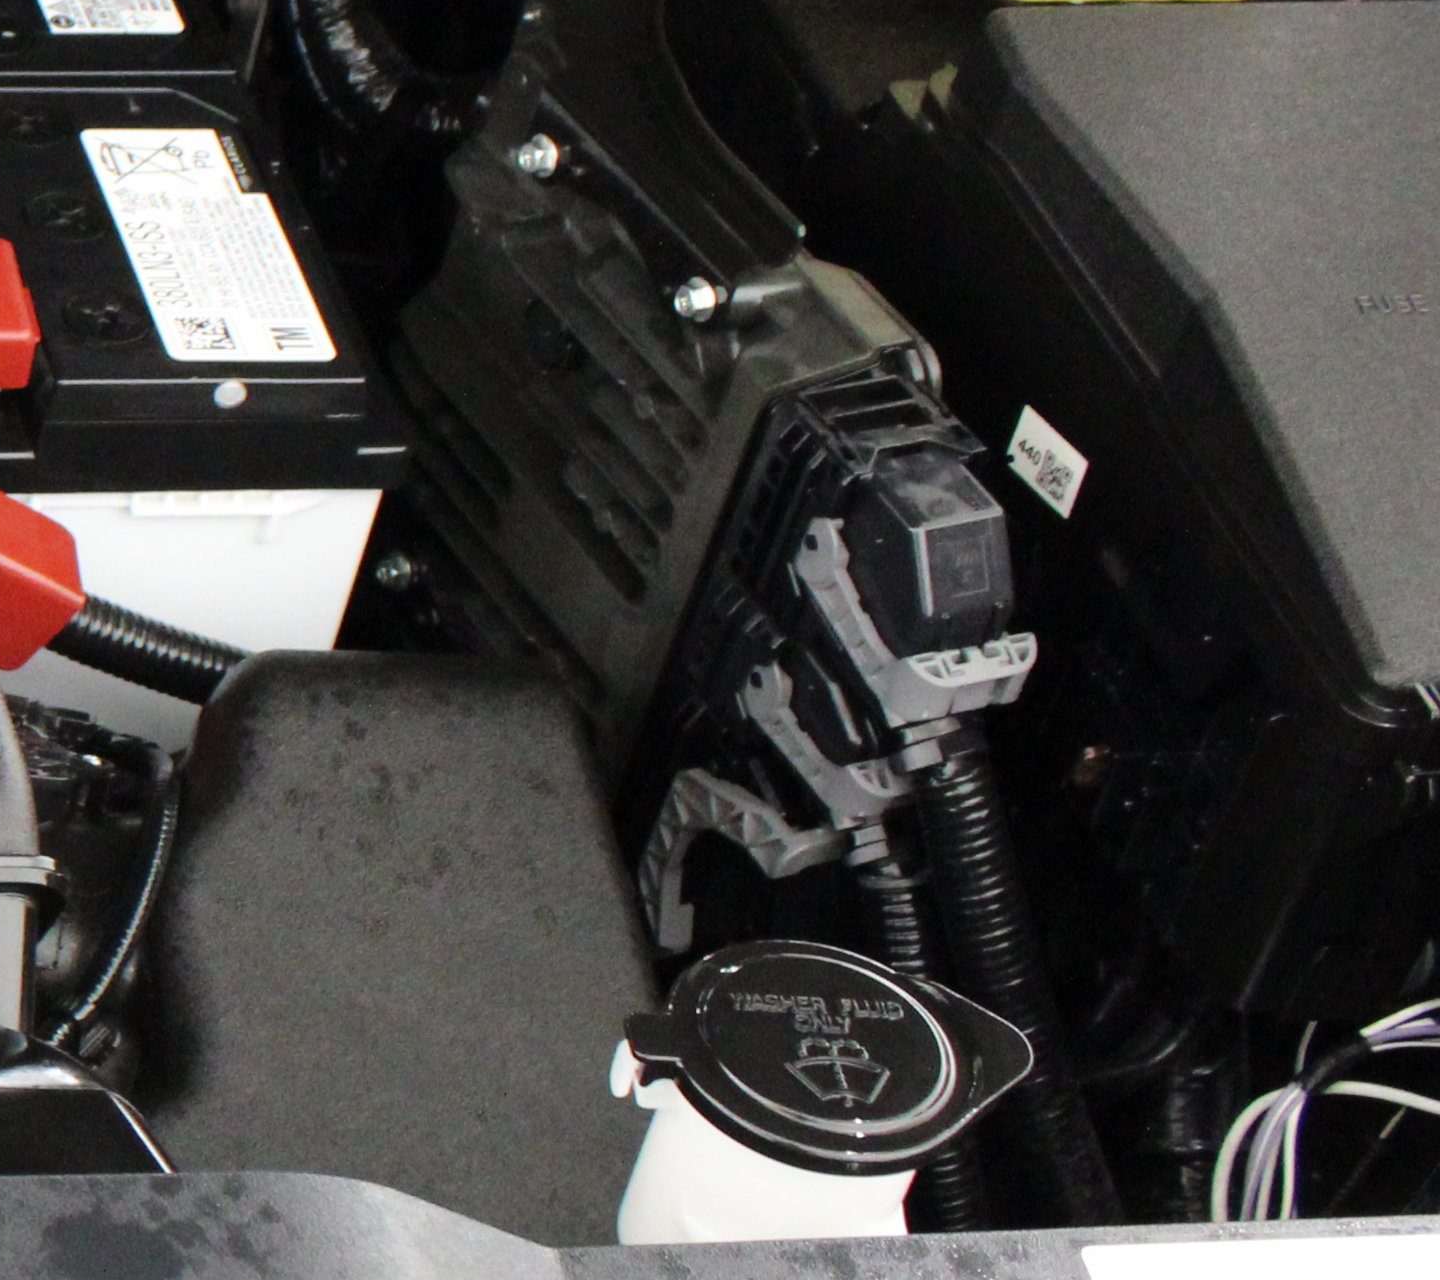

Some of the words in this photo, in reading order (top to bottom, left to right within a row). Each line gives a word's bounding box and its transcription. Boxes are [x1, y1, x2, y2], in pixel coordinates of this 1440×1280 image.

[1352, 294, 1430, 313] FUSE
[1018, 439, 1042, 466] 440
[728, 992, 827, 1014] WASHER
[839, 998, 905, 1021] FLUID
[792, 1014, 850, 1034] ONLY
